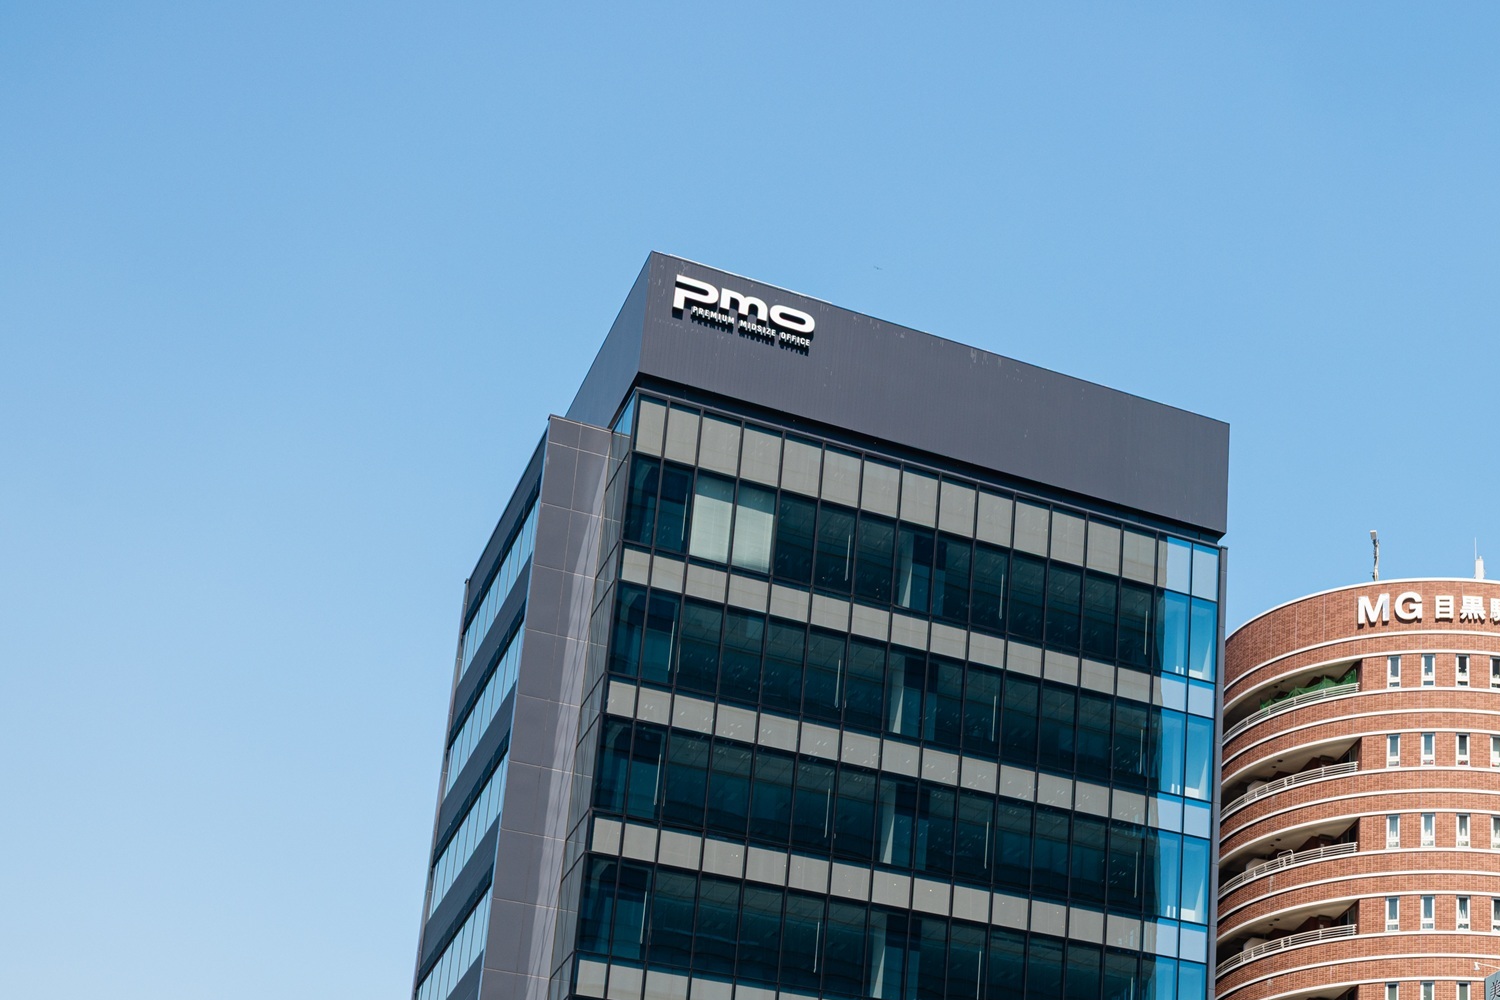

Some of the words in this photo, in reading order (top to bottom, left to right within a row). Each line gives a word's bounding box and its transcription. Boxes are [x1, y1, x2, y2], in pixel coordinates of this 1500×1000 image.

[691, 305, 735, 324] PREMIUM
[739, 319, 776, 337] MIDSIZE
[780, 331, 811, 347] OFFICE
[1357, 591, 1423, 626] MG
